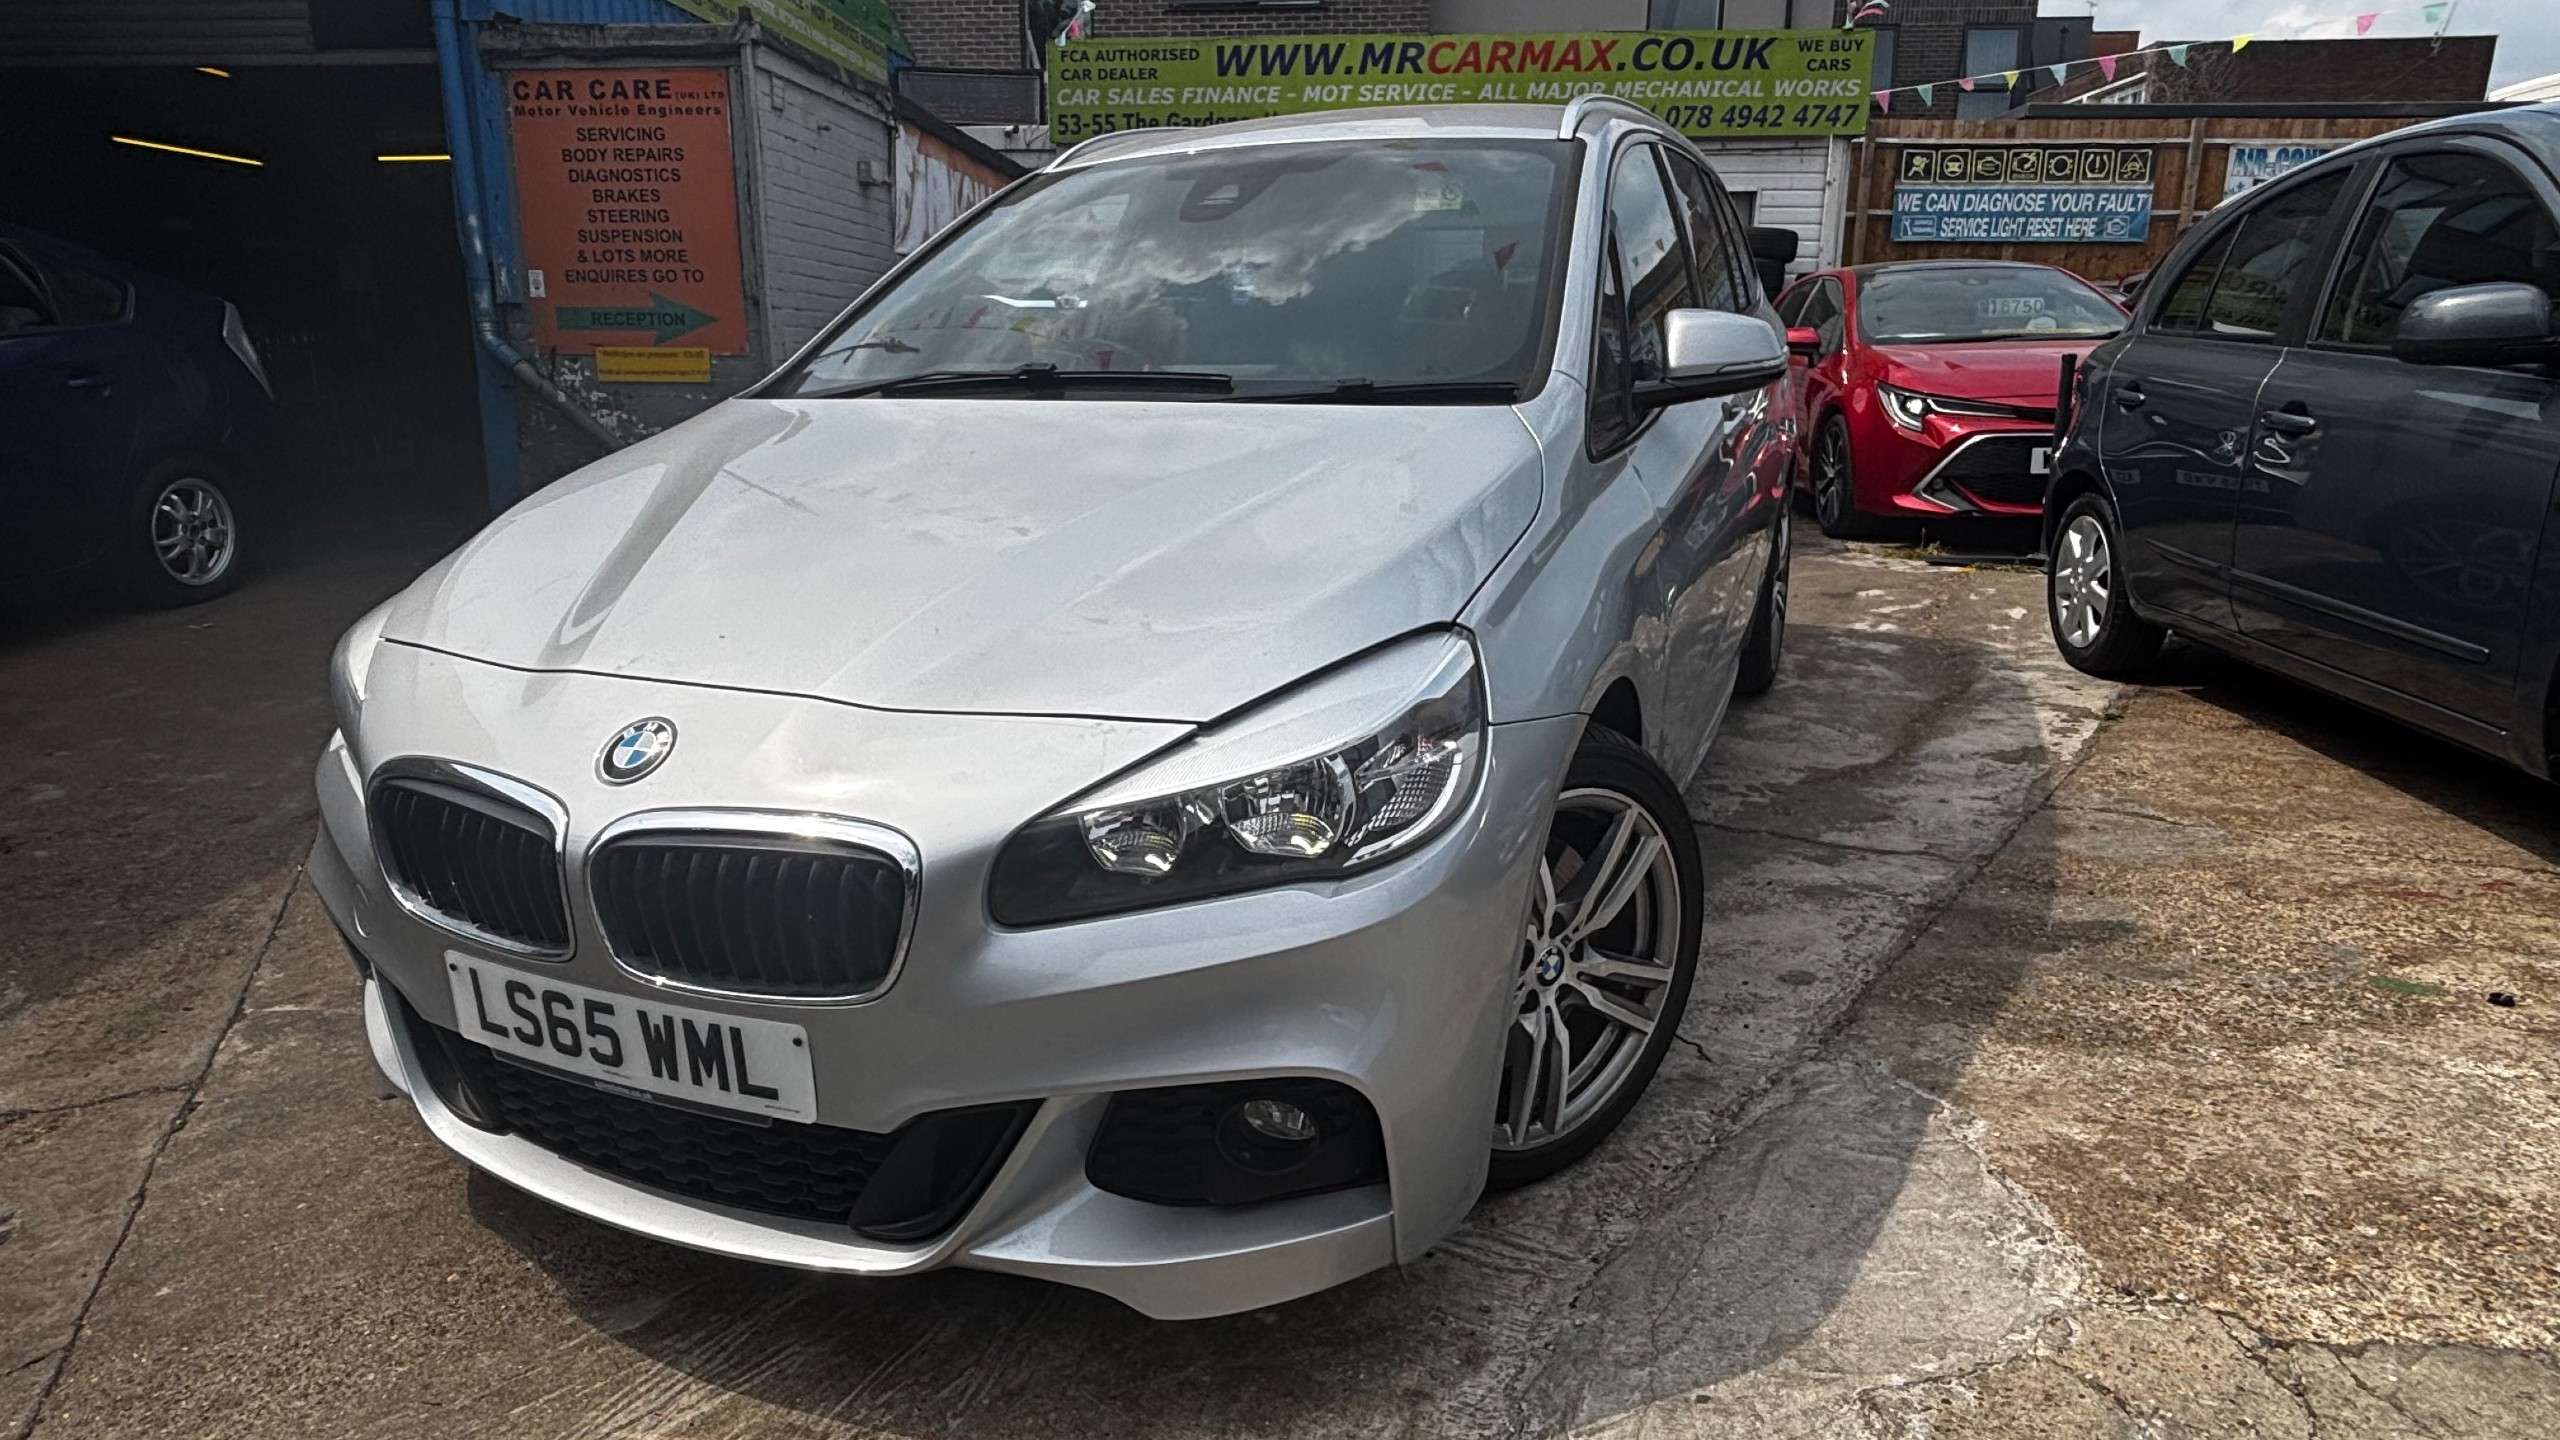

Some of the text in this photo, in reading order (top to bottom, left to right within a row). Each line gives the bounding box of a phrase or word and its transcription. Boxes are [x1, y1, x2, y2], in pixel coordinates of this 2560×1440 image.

[1798, 38, 1864, 53] WE BUY
[1060, 48, 1199, 63] FCA AUTHORISED
[1215, 36, 1778, 77] WWW.MRCARMAX.CO.UK
[1806, 57, 1851, 71] CARS
[1060, 67, 1158, 81] CAR DEALER
[513, 79, 575, 101] CAR
[588, 79, 673, 100] CARE
[702, 90, 725, 100] LTD
[1057, 88, 1100, 107] CAR
[1107, 87, 1175, 106] SALES
[1182, 86, 1281, 105] FINANCE
[1304, 84, 1352, 103] MOT
[1358, 83, 1457, 102] SERVICE
[1477, 82, 1518, 101] ALL
[1526, 82, 1606, 100] MAJOR
[1612, 80, 1766, 99] MECHANICAL
[1774, 79, 1862, 98] WORKS
[513, 103, 722, 118] Motor Vehicle Engineers
[1664, 104, 1714, 128] 078
[1719, 104, 1784, 128] 4942
[1793, 104, 1860, 128] 4747
[1057, 113, 1116, 135] 53-55
[576, 127, 666, 142] SERVICING
[562, 147, 685, 163] BODY REPAIRS
[568, 168, 682, 183] DIAGNOSTICS
[592, 189, 661, 203] BRAKES
[1897, 193, 1921, 213] WE
[1925, 193, 1962, 213] CAN
[1963, 193, 2046, 213] DIAGNOSE
[2050, 193, 2096, 213] YOUR
[587, 209, 670, 224] STEERING
[1940, 217, 1989, 238] SERVICE
[1990, 217, 2025, 238] LIGHT
[2026, 217, 2063, 238] RESET
[2065, 217, 2097, 238] HERE
[577, 229, 683, 244] SUSPENSION
[576, 249, 689, 264] & LOTS MORE
[564, 269, 705, 284] ENQUIRES GO TO
[591, 312, 687, 327] RECEPTION
[468, 966, 780, 1102] LS65 WML
